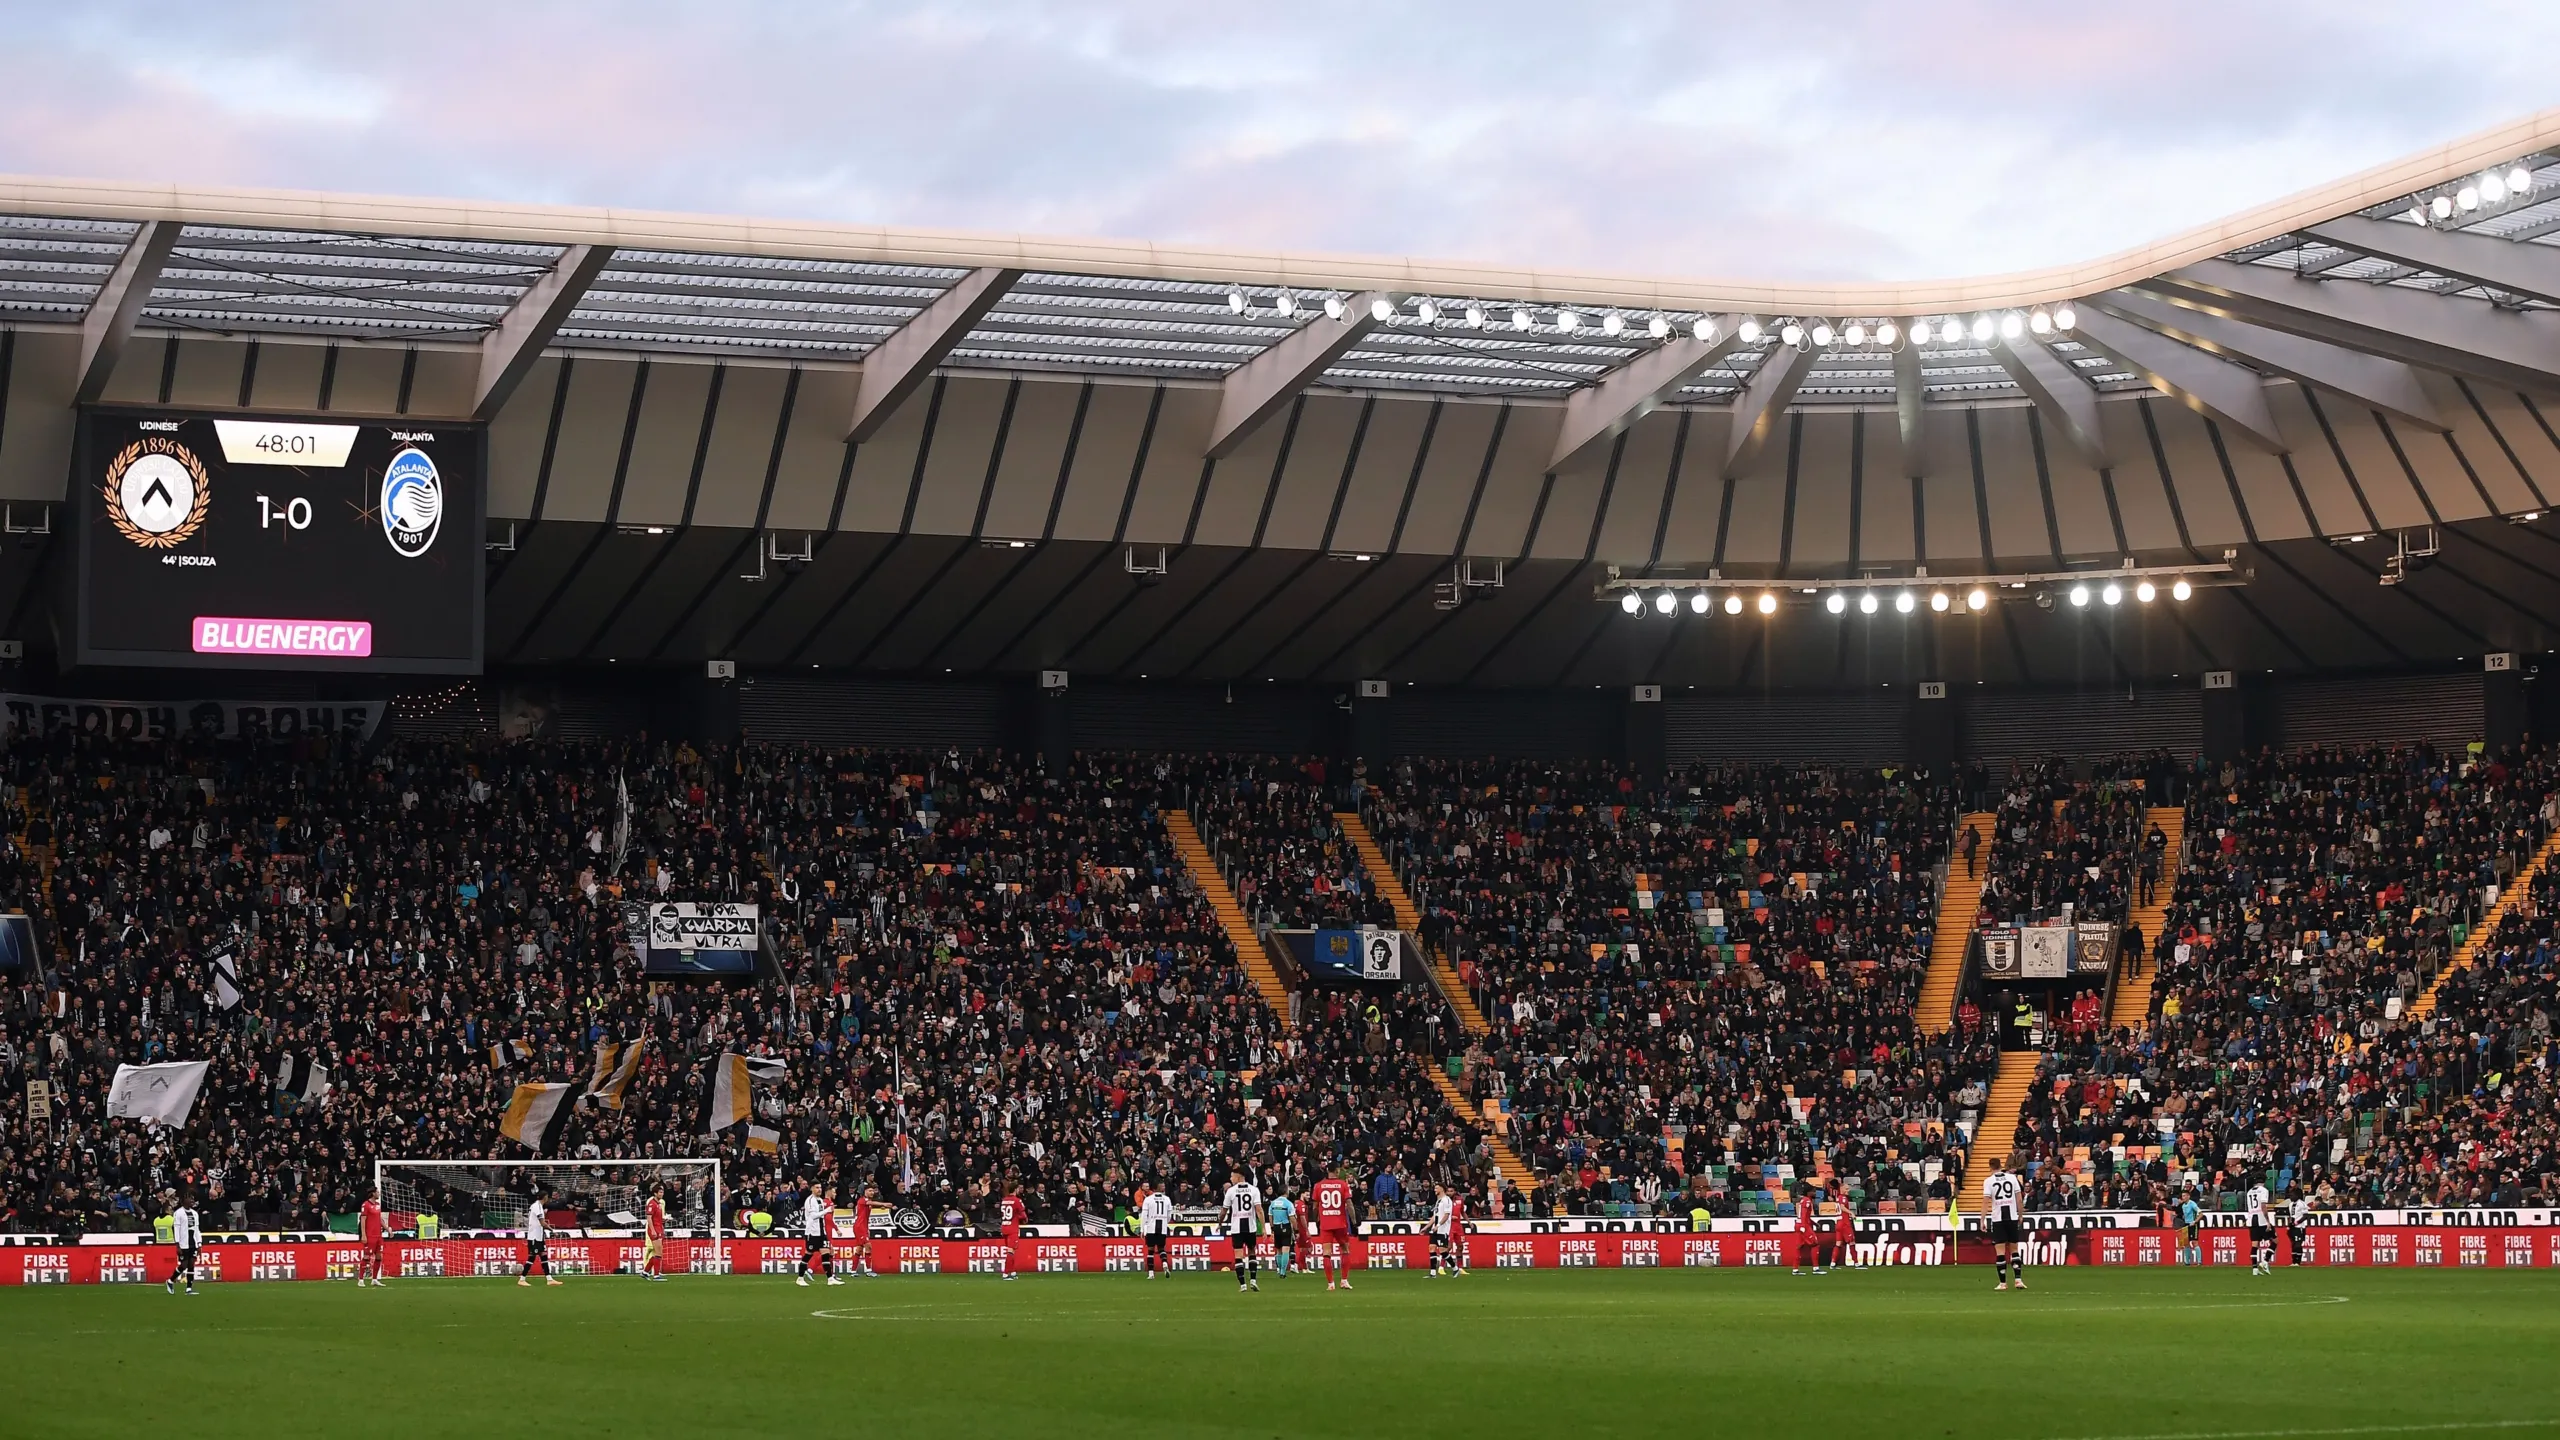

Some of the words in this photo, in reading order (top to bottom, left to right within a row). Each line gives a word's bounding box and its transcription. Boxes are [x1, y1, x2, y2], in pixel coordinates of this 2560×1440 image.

[140, 421, 178, 431] UDINESE
[391, 432, 434, 441] ATALANTA
[142, 437, 176, 454] 1896
[255, 435, 315, 454] 48:01
[391, 464, 433, 479] ATALANTA
[257, 496, 312, 530] 1-0
[398, 532, 423, 544] 1907
[201, 623, 365, 651] BLUENERGY
[2491, 657, 2503, 667] 12
[718, 664, 725, 674] 6
[1052, 674, 1059, 684] 7
[2212, 676, 2224, 685] 11
[1371, 684, 1377, 694] 8
[1645, 689, 1652, 698] 9
[1926, 686, 1939, 695] 10
[6, 701, 176, 742] TEDDY
[685, 919, 752, 933] GUARDIA
[2079, 923, 2109, 931] UDINESE
[656, 931, 674, 945] NGU
[694, 935, 743, 949] ULTRA
[1992, 1181, 2013, 1199] 29
[1236, 1194, 1252, 1212] 18
[1321, 1190, 1341, 1209] 90
[2248, 1194, 2258, 1209] 13
[1001, 1205, 1013, 1220] 59
[1155, 1201, 1164, 1214] 11
[1560, 1240, 1596, 1251] FIBRE
[1622, 1240, 1658, 1250] FIBRE
[1684, 1240, 1720, 1251] FIBRE
[1746, 1240, 1780, 1250] FIBRE
[2103, 1236, 2124, 1248] FIBRE
[2139, 1236, 2160, 1248] FIBRE
[2214, 1236, 2236, 1248] FIBRE
[2330, 1234, 2354, 1246] FIBRE
[2372, 1234, 2398, 1246] FIBRE
[2416, 1235, 2442, 1247] FIBRE
[2460, 1236, 2486, 1248] FIBRE
[2505, 1236, 2532, 1248] FIBRE
[474, 1247, 516, 1258] FIBRE
[548, 1247, 588, 1258] FIBRE
[620, 1247, 645, 1258] FIB
[762, 1247, 802, 1258] FIBRE
[900, 1246, 940, 1258] FIBRE
[968, 1246, 1007, 1257] FIBRE
[1038, 1246, 1076, 1256] FIBRE
[1106, 1244, 1144, 1256] FIBRE
[1172, 1244, 1210, 1255] FIBRE
[1368, 1243, 1404, 1254] FIBRE
[1496, 1242, 1532, 1252] FIBRE
[2018, 1231, 2067, 1265] nfront
[101, 1254, 144, 1266] FIBRE
[252, 1252, 295, 1264] FIBRE
[401, 1248, 444, 1260] FIBRE
[1496, 1254, 1533, 1266] NET
[1560, 1253, 1596, 1265] NET
[1622, 1252, 1658, 1264] NET
[1746, 1252, 1780, 1264] NET
[2103, 1250, 2124, 1262] NET
[2139, 1250, 2161, 1262] NET
[2214, 1250, 2236, 1262] NET
[2330, 1248, 2355, 1262] NET
[2372, 1248, 2398, 1262] NET
[2416, 1248, 2442, 1263] NET
[2460, 1249, 2486, 1264] NET
[2506, 1249, 2532, 1264] NET
[24, 1254, 68, 1267] FIBRE
[900, 1260, 940, 1272] NET
[1038, 1259, 1077, 1272] NET
[1106, 1258, 1144, 1271] NET
[1172, 1258, 1210, 1270] NET
[1368, 1256, 1405, 1268] NET
[194, 1266, 220, 1280] ET
[252, 1266, 296, 1280] NET
[326, 1264, 360, 1278] NE
[400, 1262, 444, 1276] NET
[548, 1261, 588, 1274] NET
[620, 1260, 644, 1274] NE
[24, 1268, 68, 1282] NET
[101, 1268, 144, 1282] NET
